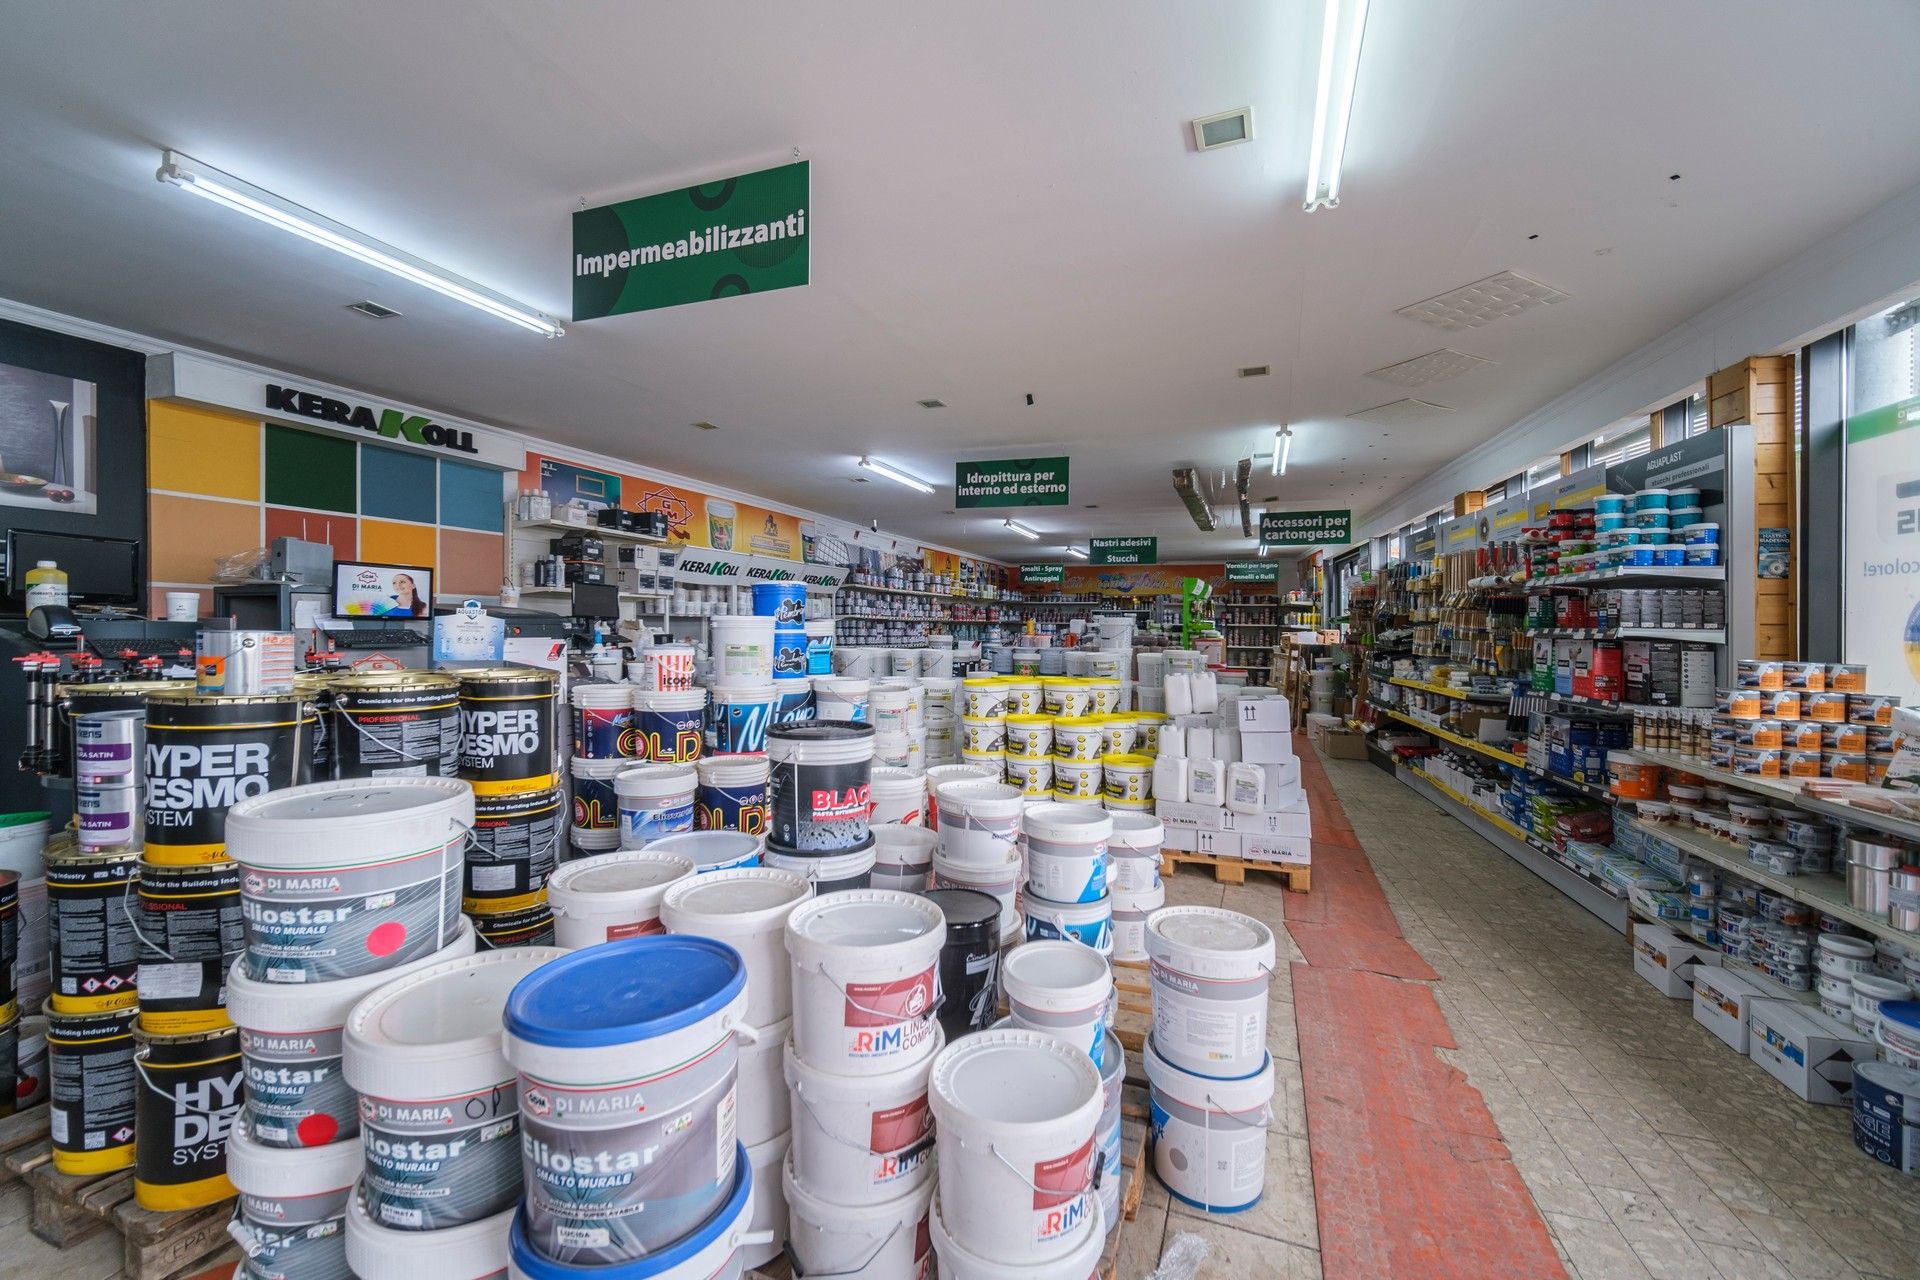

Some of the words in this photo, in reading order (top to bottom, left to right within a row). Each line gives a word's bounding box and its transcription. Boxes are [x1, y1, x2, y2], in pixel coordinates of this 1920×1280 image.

[576, 208, 805, 277] Impermeabilizzanti
[266, 384, 478, 454] KERAKOLL
[967, 471, 1031, 485] Idropittura
[1034, 471, 1055, 484] per
[958, 485, 1000, 496] interno
[1003, 483, 1018, 494] ed
[1020, 483, 1066, 494] esterno
[1262, 516, 1322, 528] Accessori
[1325, 516, 1348, 528] per
[1264, 529, 1346, 541] cartongesso
[1093, 539, 1119, 547] Nastri
[1120, 538, 1152, 547] adesivi
[1107, 555, 1138, 563] Stucchi
[679, 560, 740, 576] KERAKOLL
[746, 567, 795, 581] KERAKOLL
[1044, 565, 1063, 573] Spray
[802, 574, 841, 587] KERAKOLL
[1024, 575, 1060, 583] Antiruggini
[357, 697, 392, 705] Chemicals
[358, 714, 421, 723] PROFESSIONAL
[89, 751, 114, 759] SATIN
[88, 820, 112, 828] SATIN
[1271, 849, 1292, 857] MARIA
[166, 880, 180, 888] the
[182, 878, 219, 890] Building
[267, 878, 282, 889] DI
[285, 877, 340, 890] MARIA
[283, 925, 328, 935] MURALE
[1159, 969, 1169, 980] DI
[1169, 976, 1200, 990] MARIA
[82, 1025, 120, 1037] Industry
[253, 1036, 264, 1048] DI
[267, 1038, 316, 1050] MARIA
[267, 1085, 306, 1095] MURALE
[555, 1098, 573, 1112] DI
[579, 1092, 646, 1113] MARIA
[379, 1105, 392, 1119] DI
[396, 1107, 453, 1121] MARIA
[522, 1130, 660, 1175] Eliostar
[395, 1161, 441, 1173] MURALE
[536, 1168, 576, 1188] SMALTO
[577, 1172, 634, 1188] MURALE
